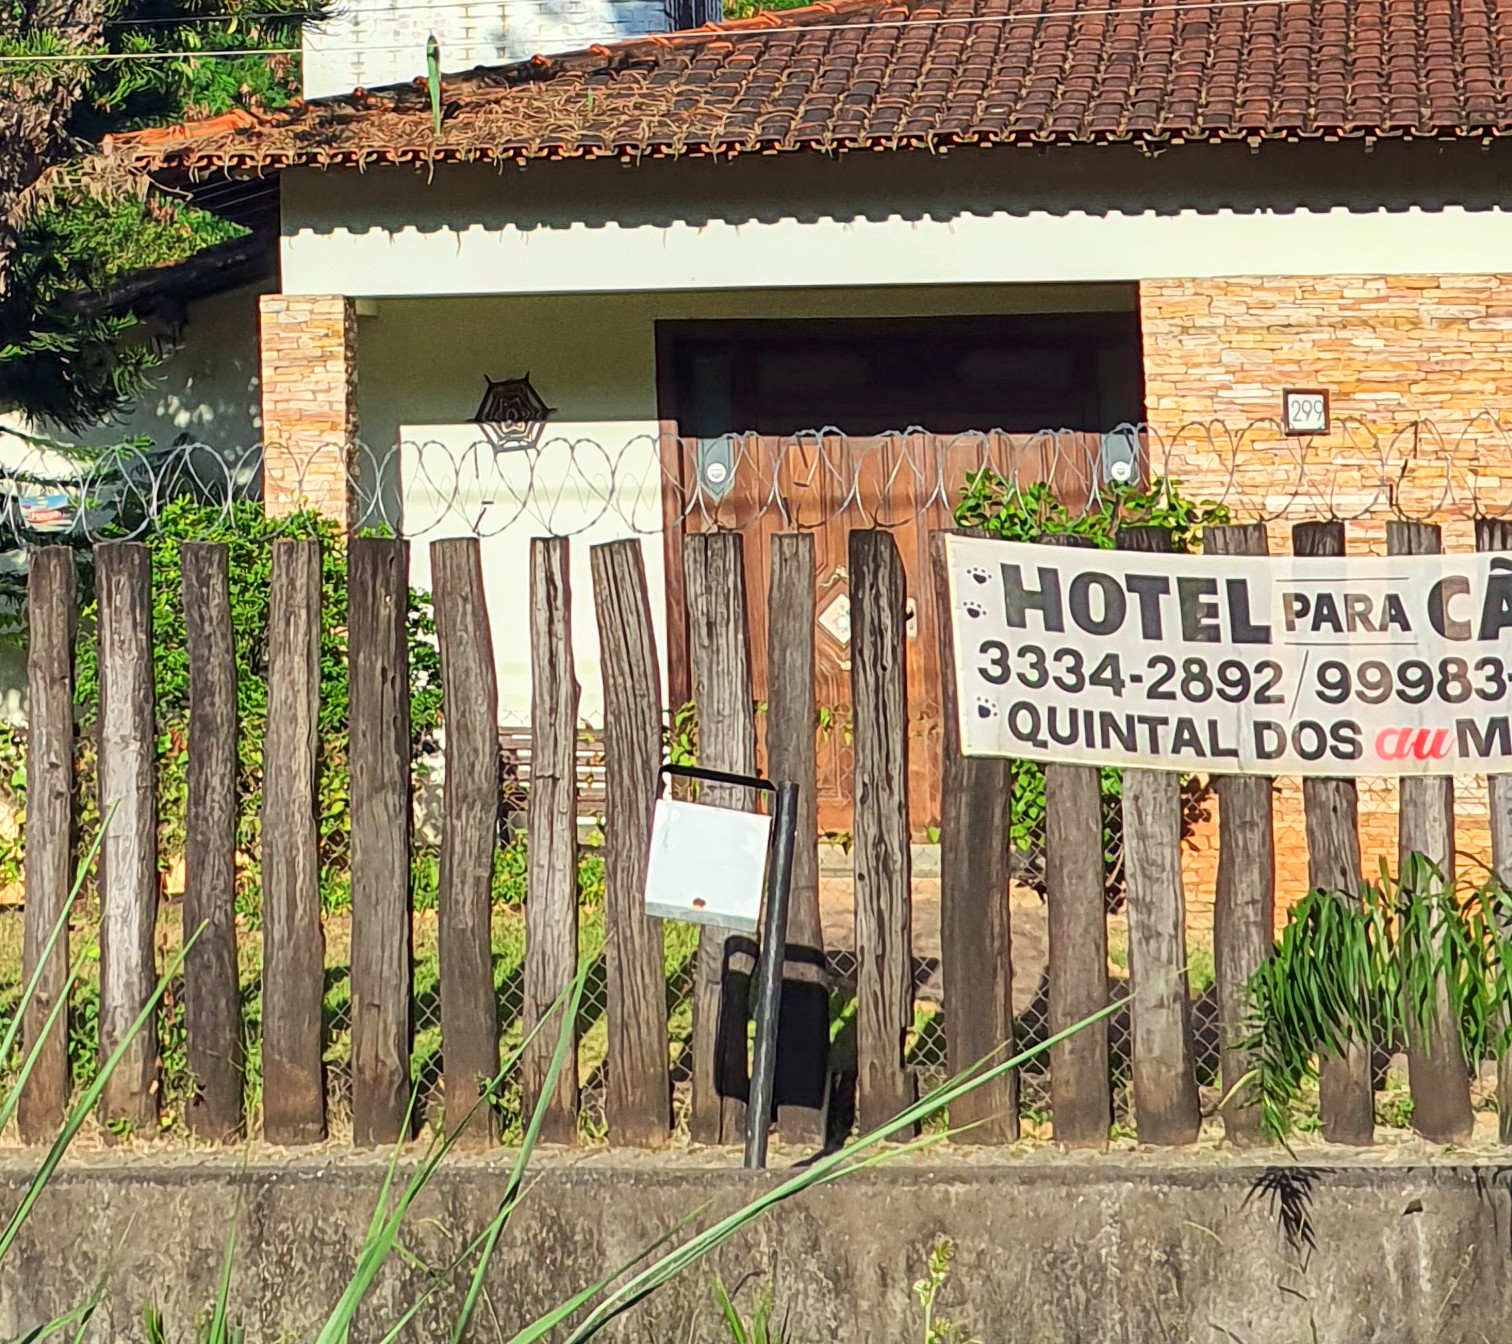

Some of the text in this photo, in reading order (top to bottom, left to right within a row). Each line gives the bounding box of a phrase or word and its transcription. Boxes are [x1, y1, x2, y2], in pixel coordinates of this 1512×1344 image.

[1291, 400, 1323, 422] 299
[999, 562, 1273, 645] HOTEL
[1282, 592, 1413, 633] PARA
[1007, 700, 1239, 759] QUINTAL
[1253, 719, 1364, 761] DOS
